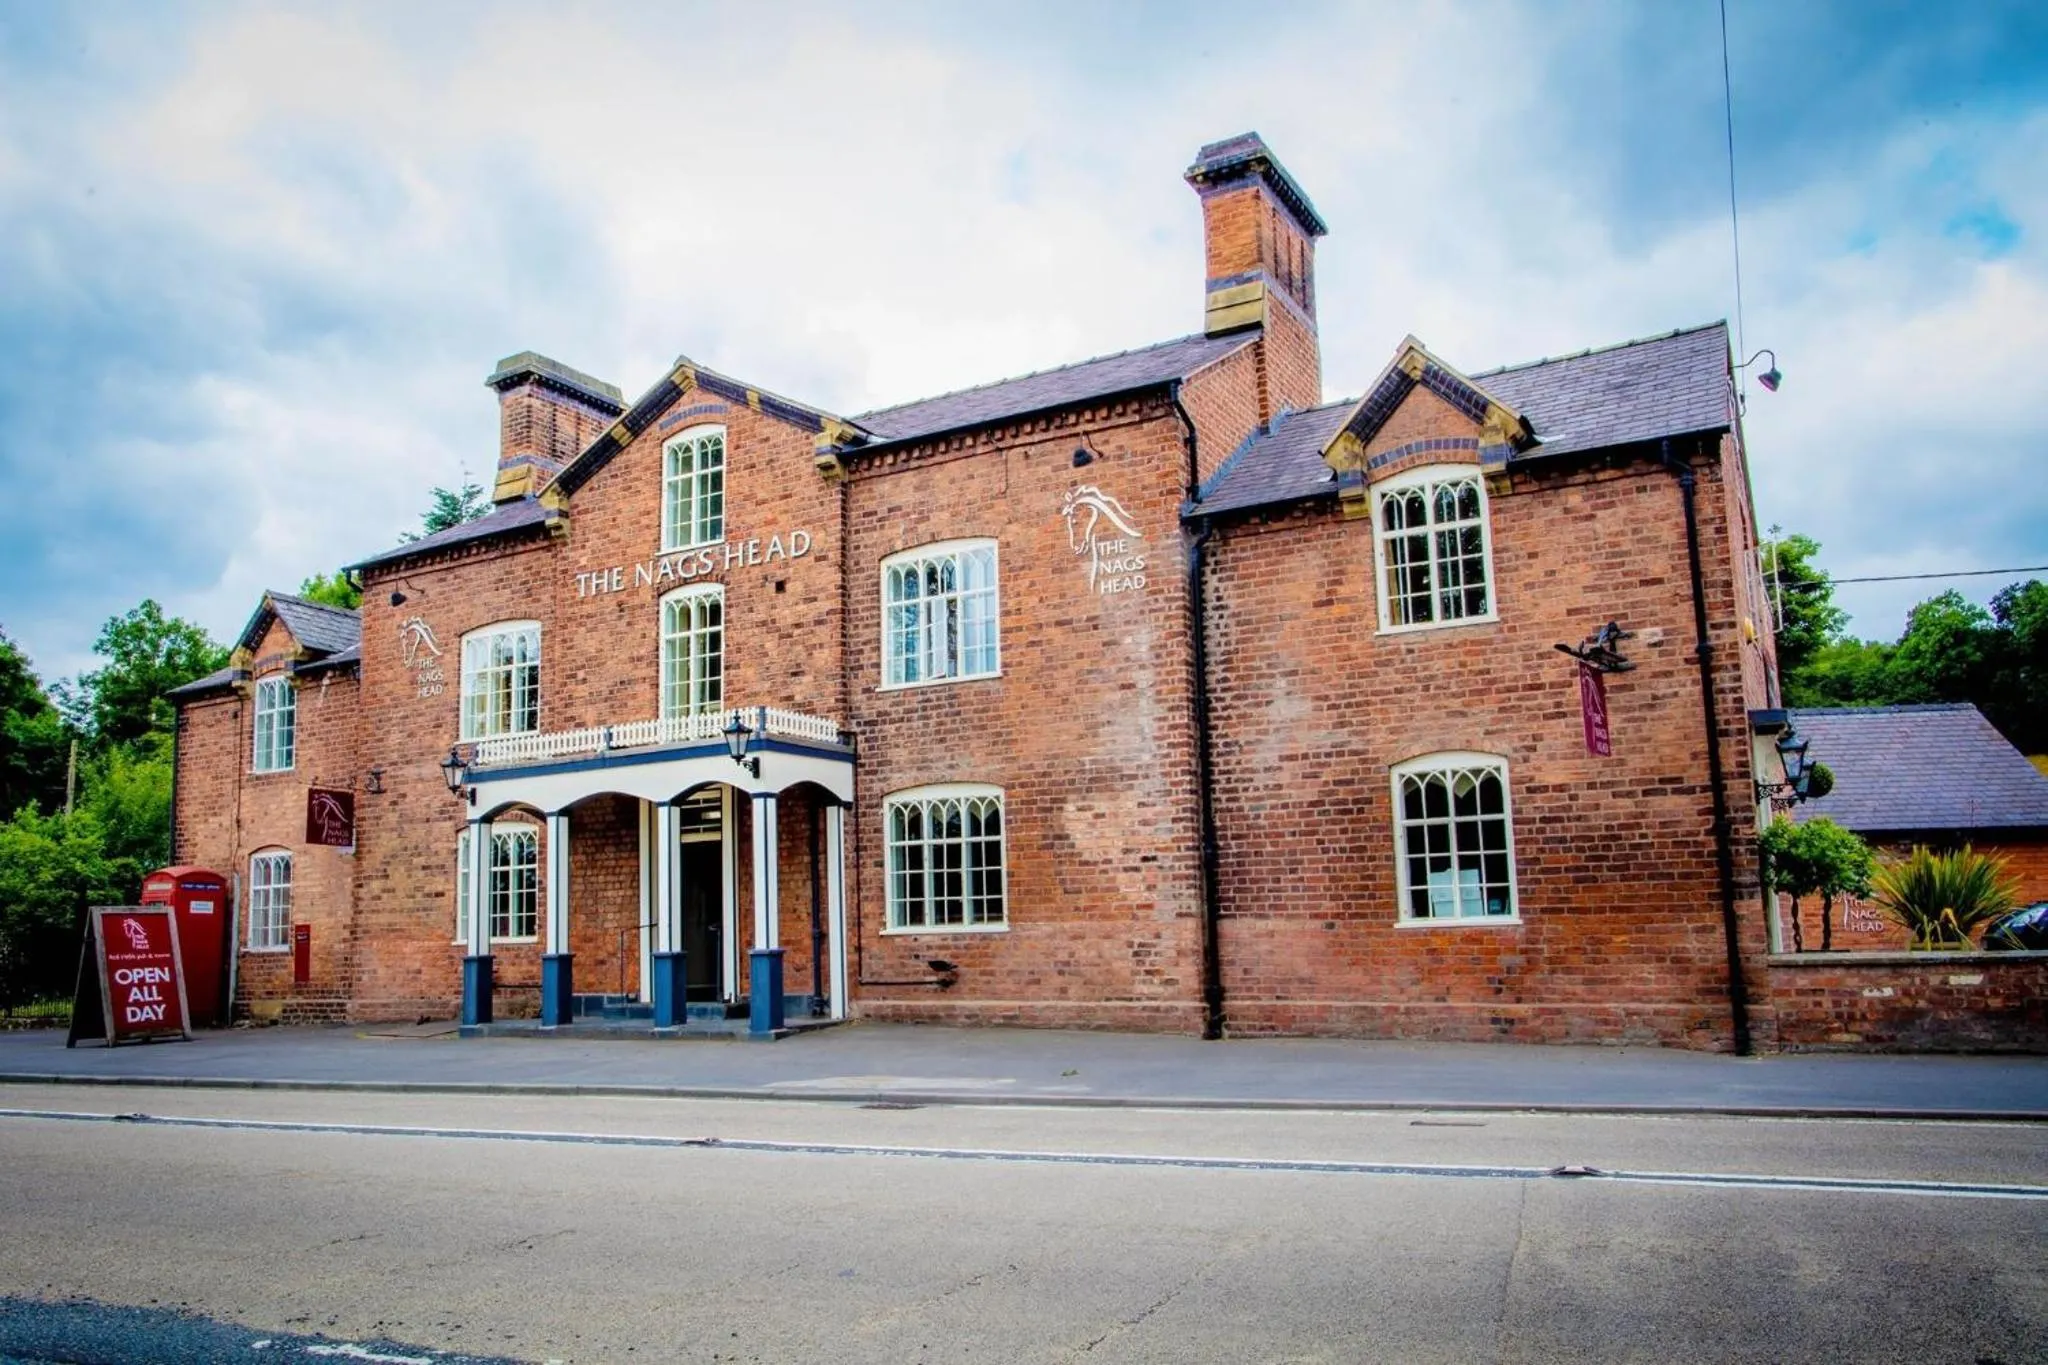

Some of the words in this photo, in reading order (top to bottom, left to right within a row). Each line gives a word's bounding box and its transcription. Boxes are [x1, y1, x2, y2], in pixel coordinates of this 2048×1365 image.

[1097, 539, 1129, 556] THE
[576, 567, 625, 599] THE
[634, 549, 714, 588] NAGS
[723, 530, 812, 570] HEAD
[1100, 555, 1146, 575] NAGS
[1100, 575, 1146, 595] HEAD
[417, 657, 436, 669] THE
[417, 670, 445, 684] NAGS
[417, 684, 444, 699] HEAD
[1851, 920, 1883, 931] HEAD
[115, 967, 170, 985] OPEN
[128, 986, 163, 1003] ALL
[126, 1004, 166, 1023] DAY
